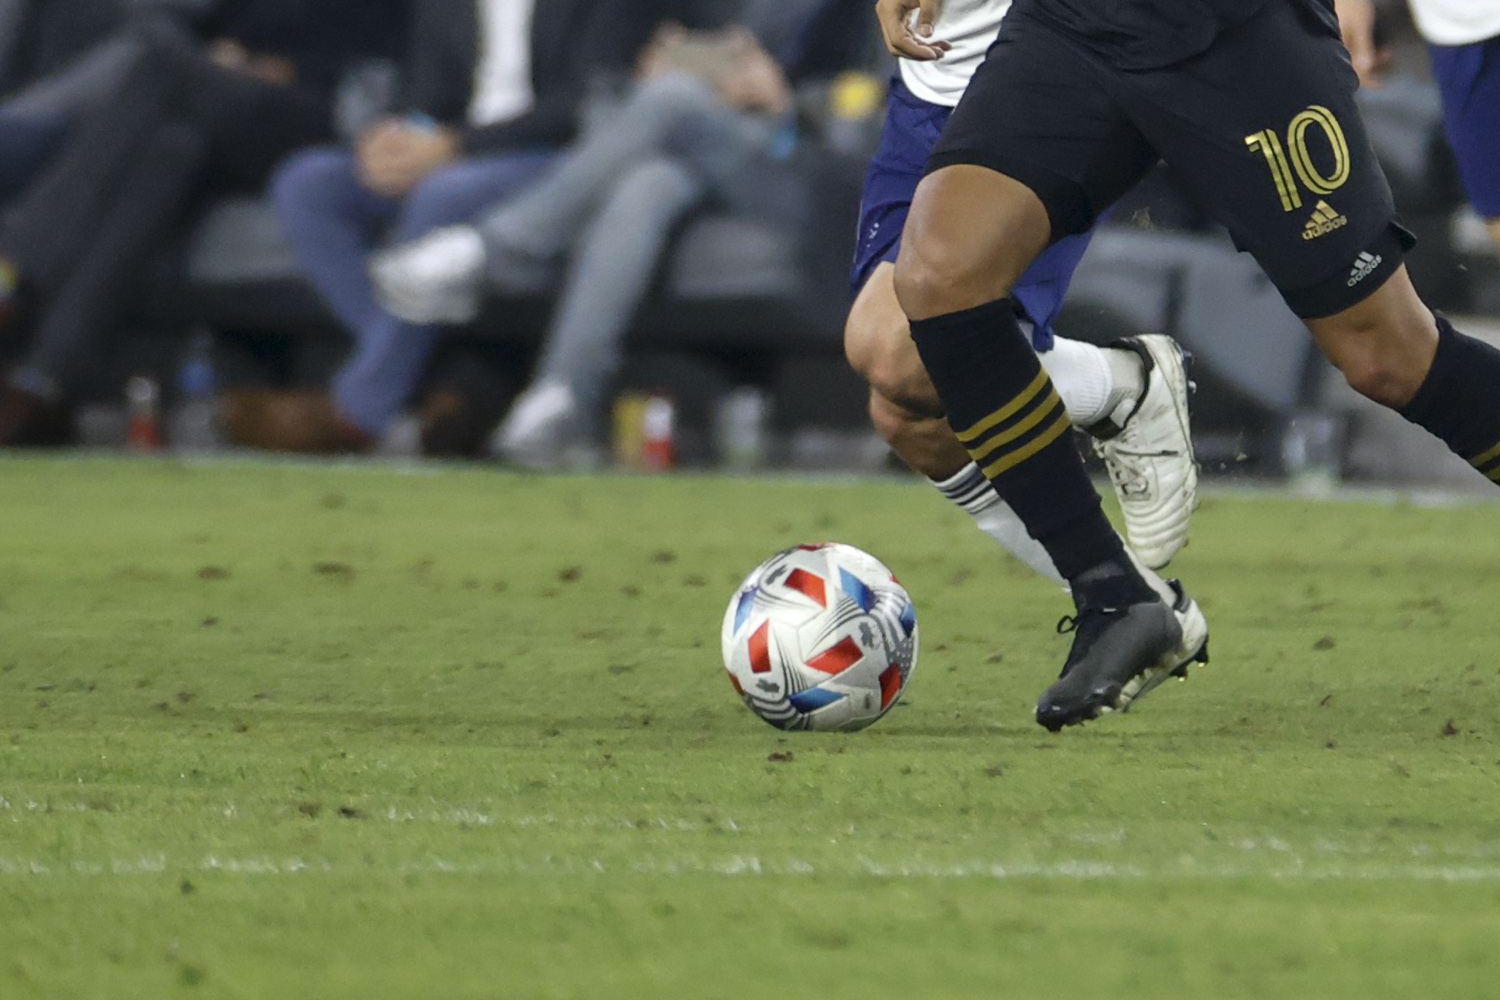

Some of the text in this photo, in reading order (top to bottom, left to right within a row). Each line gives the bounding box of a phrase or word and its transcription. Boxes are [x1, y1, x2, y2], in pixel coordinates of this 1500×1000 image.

[1244, 104, 1351, 212] 10
[1302, 214, 1348, 241] adidas
[1346, 254, 1383, 288] adidas
